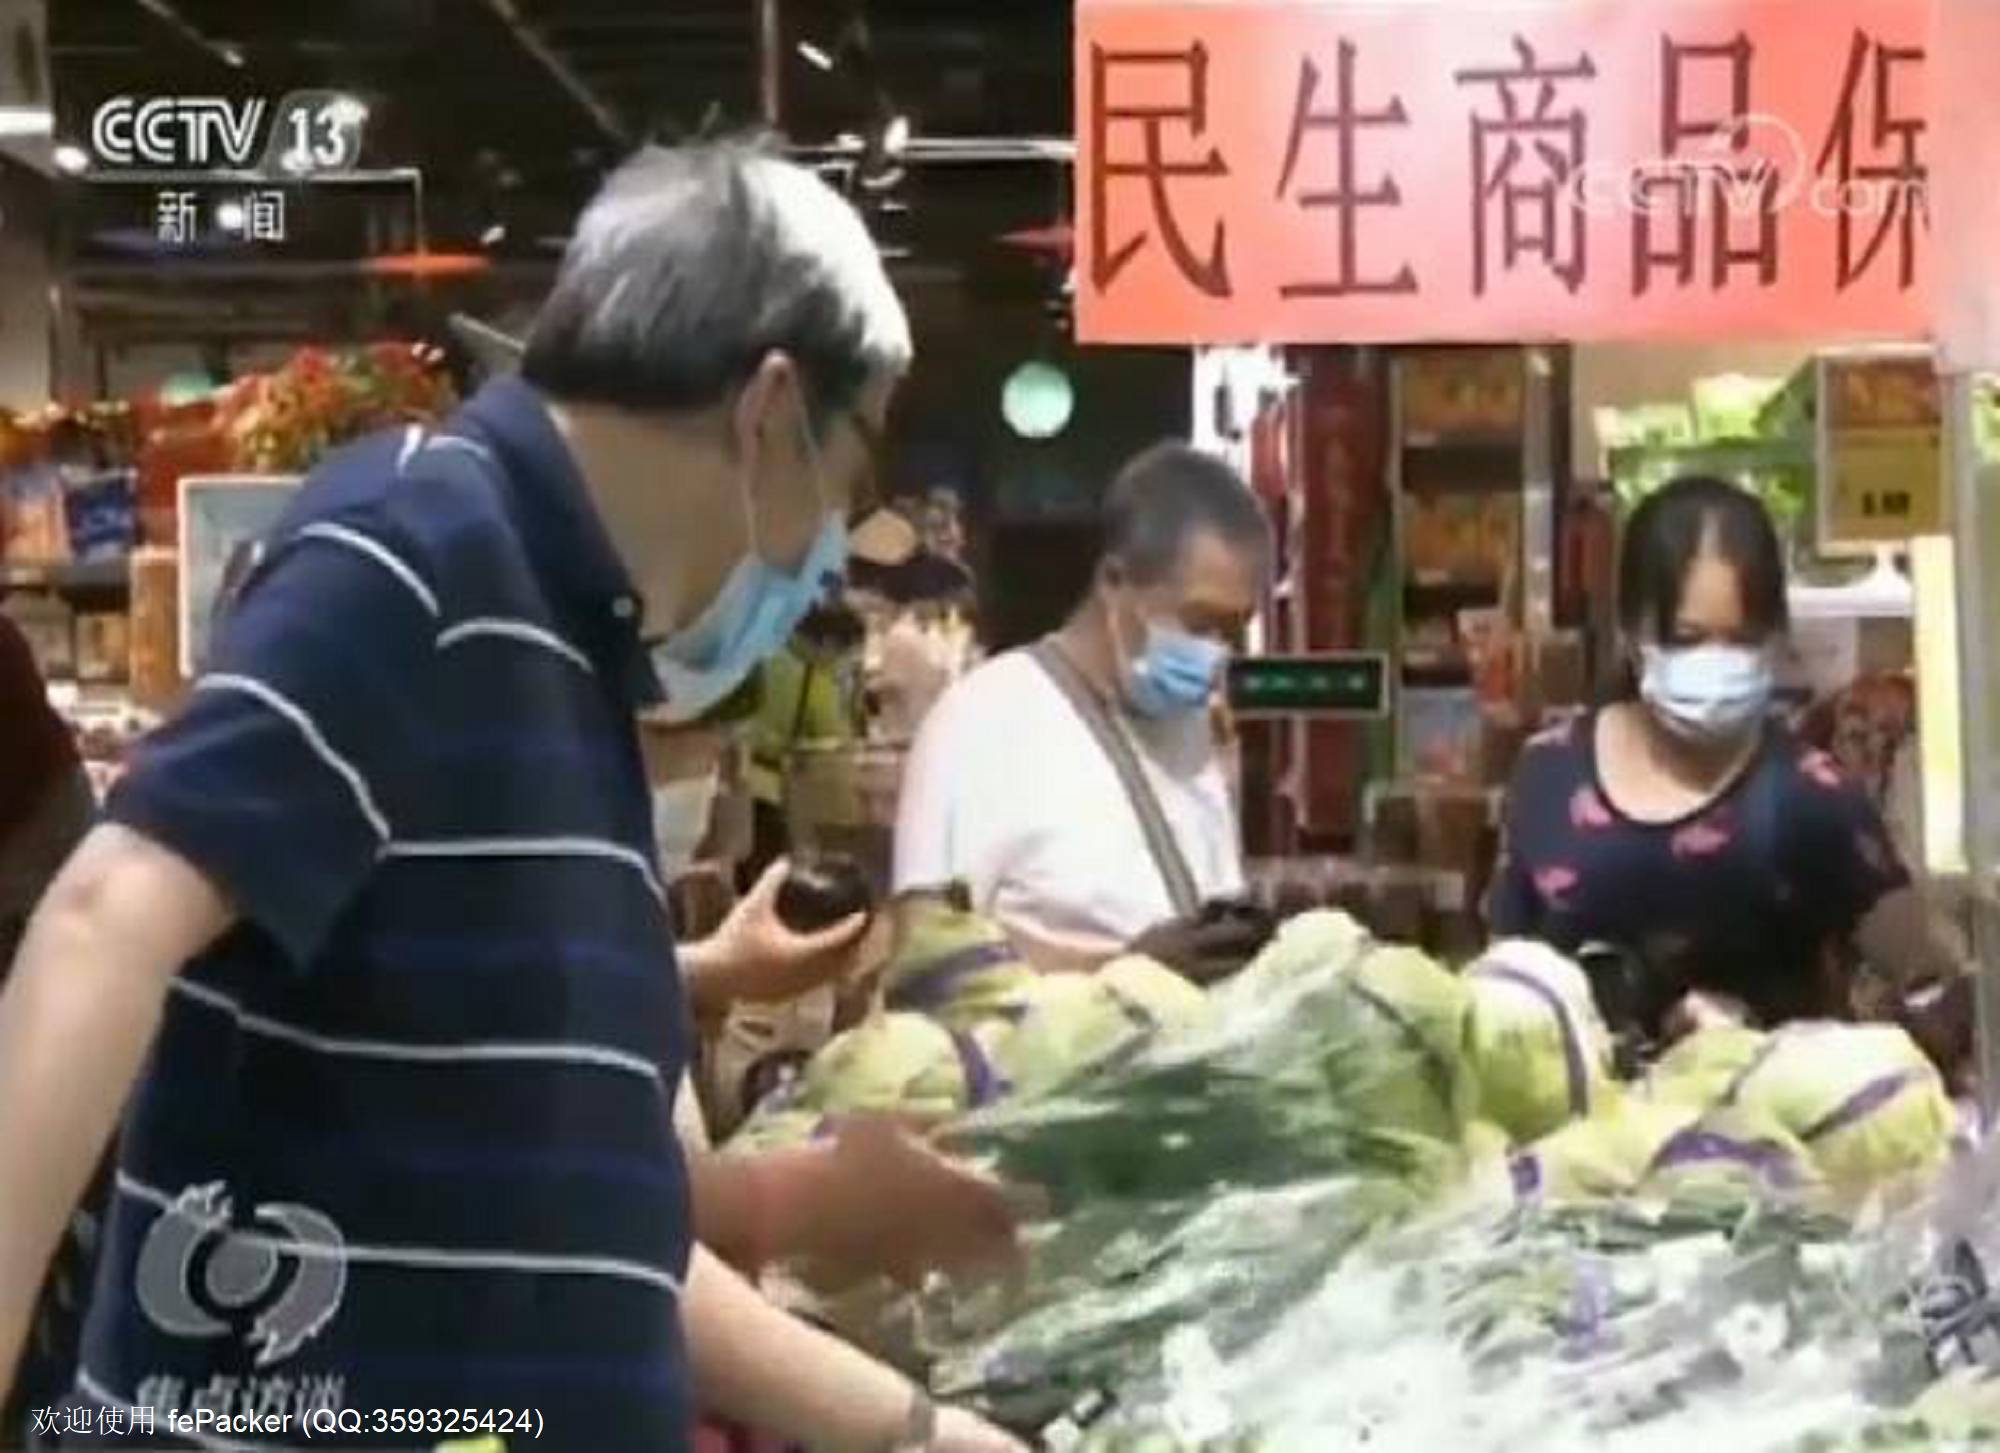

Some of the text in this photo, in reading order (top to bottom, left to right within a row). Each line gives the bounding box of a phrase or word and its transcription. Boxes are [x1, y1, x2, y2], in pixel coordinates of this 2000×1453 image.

[1085, 26, 1930, 302] 民生商品保
